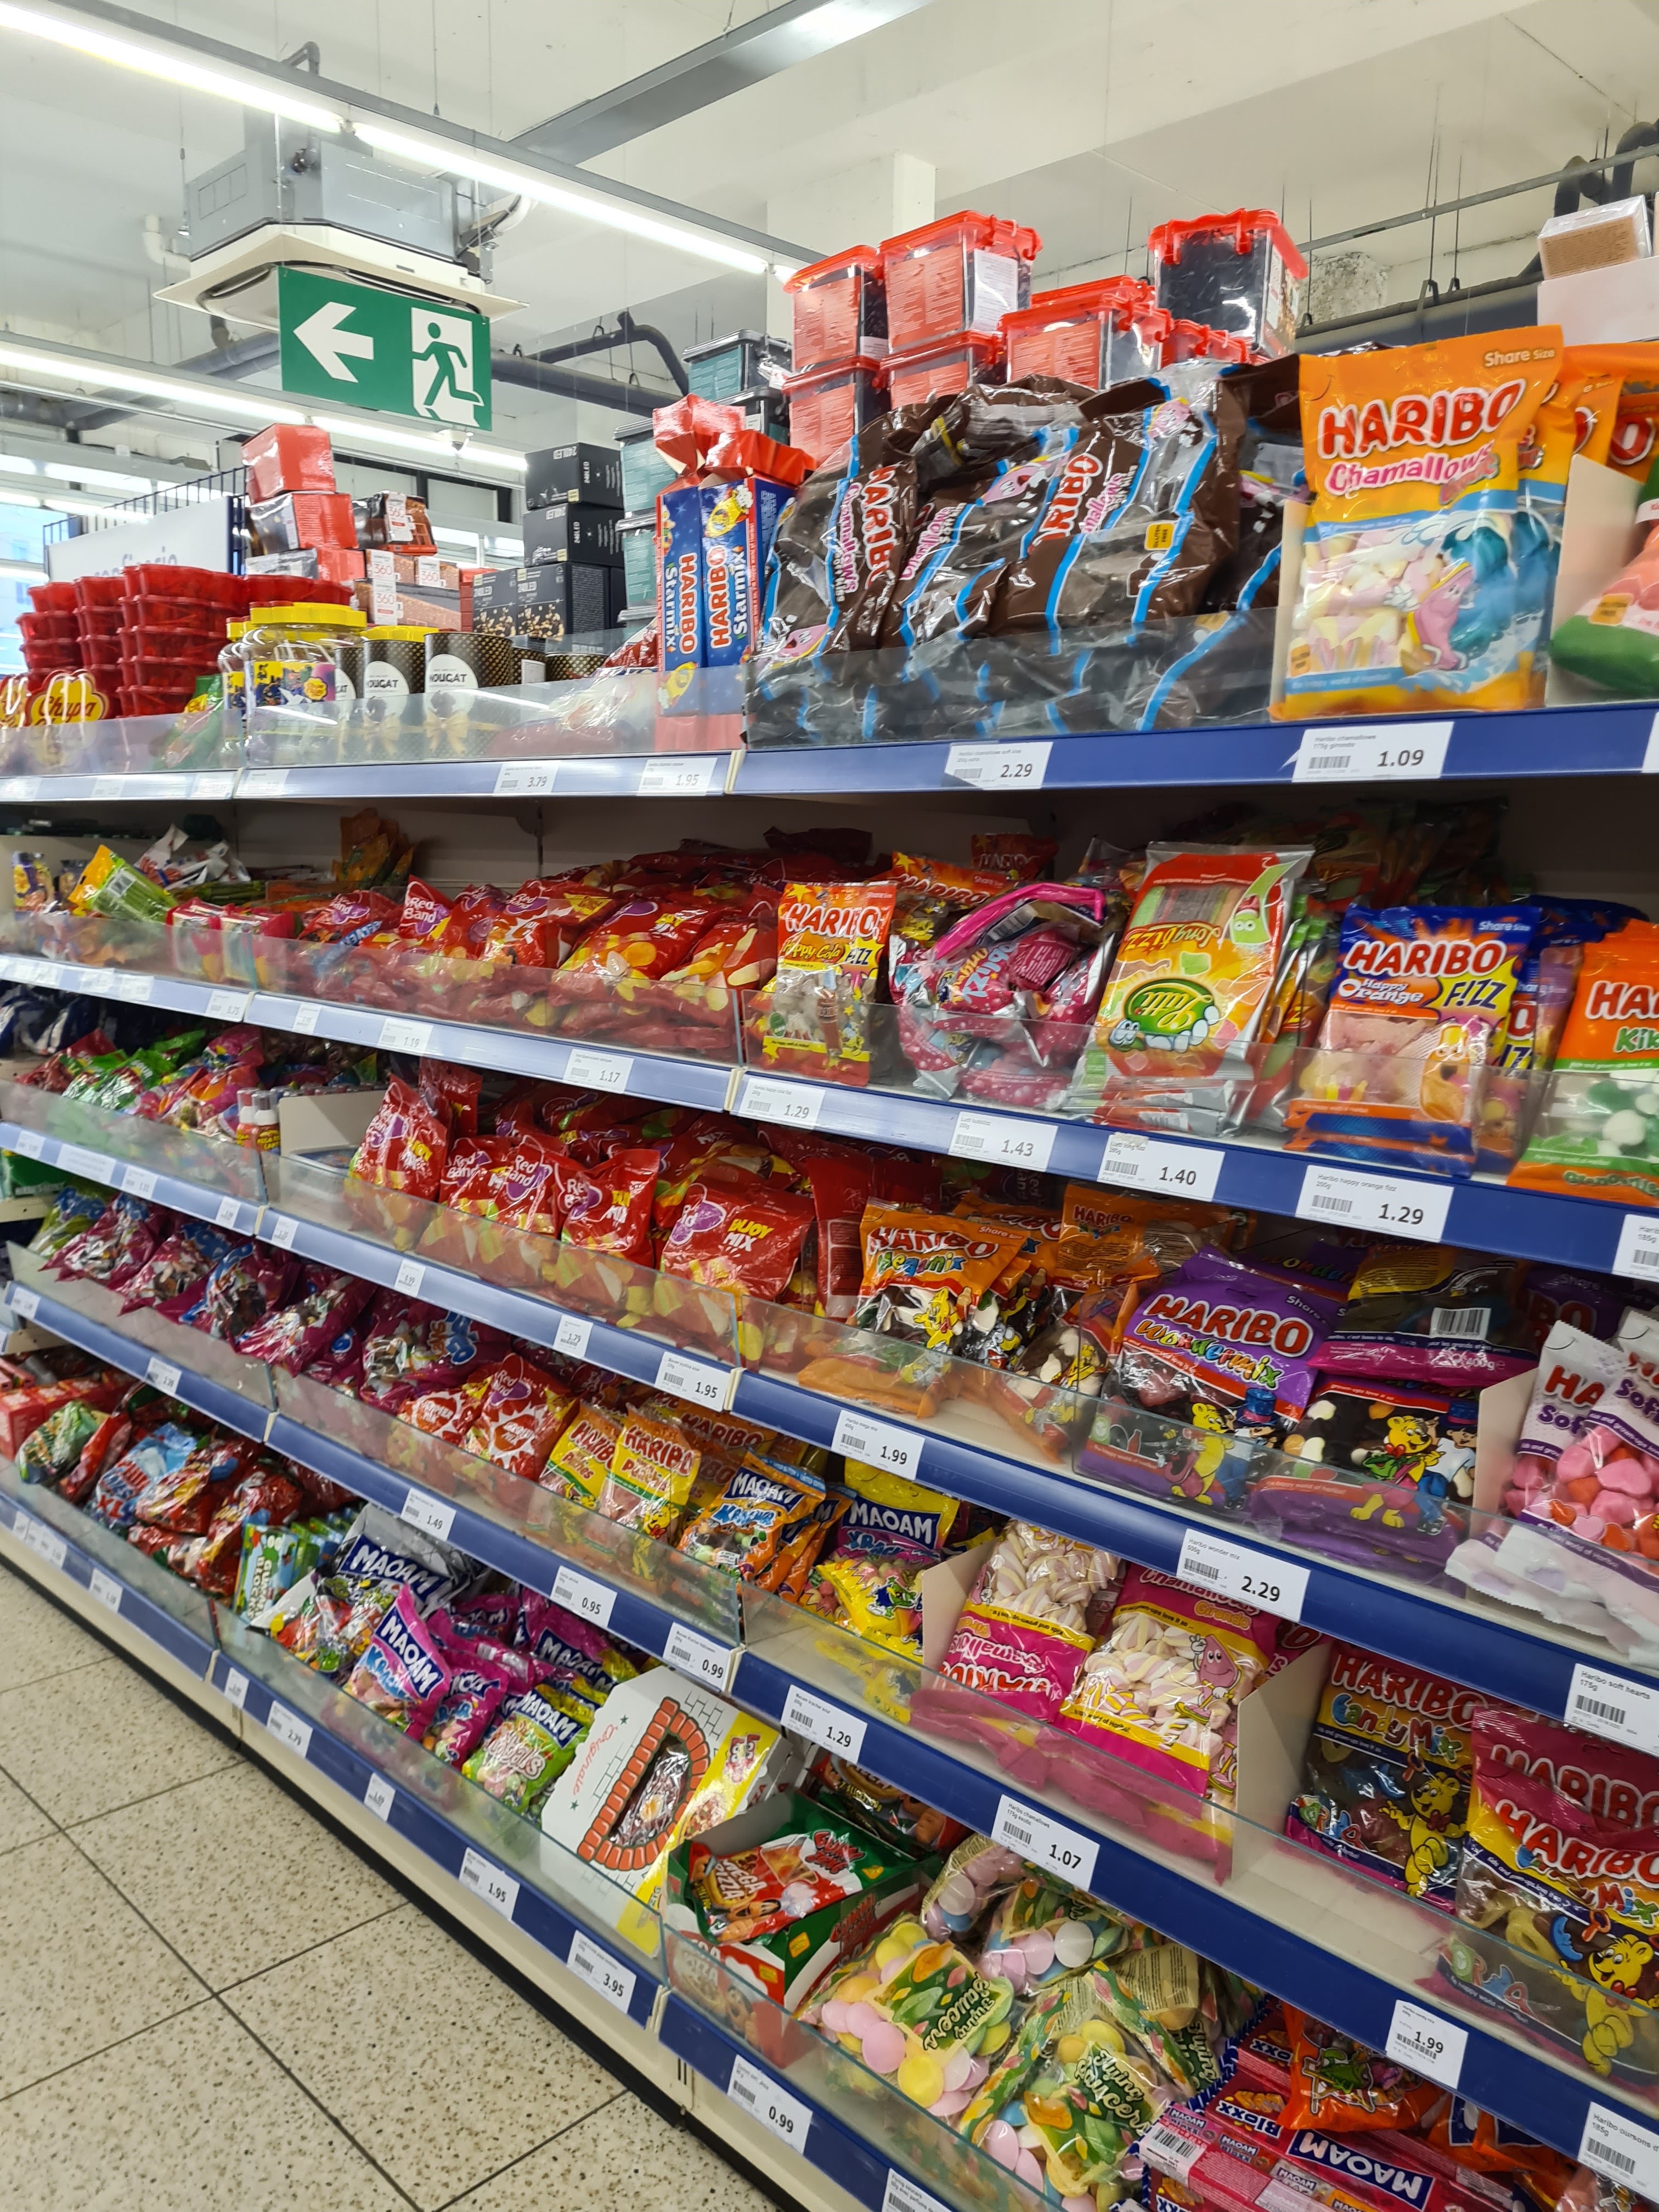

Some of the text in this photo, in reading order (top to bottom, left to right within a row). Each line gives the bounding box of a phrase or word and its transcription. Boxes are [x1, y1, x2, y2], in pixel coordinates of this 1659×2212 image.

[1484, 348, 1556, 367] Share Size
[1319, 380, 1525, 459] HARIBO
[1328, 442, 1494, 495] Chamallows
[375, 563, 392, 575] 360
[421, 571, 439, 582] 360
[376, 592, 395, 605] 360
[679, 552, 697, 654] HARIBO
[707, 546, 732, 648] HARIBO
[733, 551, 748, 635] Starmix
[665, 566, 678, 647] Starmix
[428, 673, 467, 683] NOUGAT
[40, 695, 98, 722] Chupa
[1376, 748, 1425, 768] 1.09
[527, 776, 548, 788] 3.79
[675, 773, 700, 786] 1.95
[1000, 763, 1033, 778] 2.29
[1479, 922, 1512, 932] Share
[816, 943, 842, 959] Cola
[1343, 940, 1507, 977] HARIBO
[1338, 982, 1425, 1005] Orange
[1138, 989, 1212, 1029] Lutti
[599, 1069, 622, 1084] 1.17
[783, 1104, 810, 1119] 1.29
[1001, 1139, 1035, 1157] 1.43
[514, 1154, 539, 1173] Red
[1158, 1166, 1197, 1186] 1.40
[1317, 1173, 1339, 1183] Haribo
[1339, 1176, 1361, 1188] happy
[1361, 1181, 1384, 1191] orange
[1073, 1204, 1134, 1227] HARIBO
[1378, 1203, 1425, 1226] 1.29
[723, 1232, 758, 1252] MIX
[978, 1225, 1006, 1238] Share
[1144, 1293, 1314, 1357] HARIBO
[693, 1381, 719, 1399] 1.95
[680, 1412, 765, 1449] HARIBO
[1537, 1404, 1587, 1436] Sof
[880, 1445, 909, 1465] 1.99
[427, 1515, 443, 1530] 1.49
[849, 1502, 933, 1545] MAOAM
[1188, 1538, 1207, 1549] Haribo
[352, 1544, 438, 1593] MAOAM
[1240, 1575, 1281, 1603] 2.29
[581, 1596, 602, 1615] 0.95
[381, 1615, 442, 1695] MAOAM
[702, 1658, 724, 1679] 0.99
[1331, 1654, 1488, 1732] HARIBO
[1579, 1679, 1599, 1692] 175g
[1580, 1671, 1651, 1700] Haribo soft hearts
[520, 1690, 580, 1743] MAOAM
[1331, 1693, 1463, 1762] Candy Mix
[825, 1725, 851, 1748] 1.29
[1008, 1802, 1023, 1814] Haribo
[1048, 1844, 1082, 1870] 1.07
[715, 1860, 746, 1899] PIZZA
[723, 1858, 768, 1894] MEGA
[488, 1881, 507, 1903] 1.95
[1596, 1883, 1658, 1928] Mix
[602, 1973, 624, 1997] 3.95
[1414, 2030, 1445, 2055] 1.99
[1096, 2050, 1146, 2102] Flying
[1074, 2056, 1154, 2136] Saucers
[768, 2106, 794, 2134] 0.99
[1170, 2108, 1206, 2128] MAOAM
[1593, 2114, 1654, 2151] Haribo oursons
[1220, 2134, 1259, 2155] MAOAM
[1301, 2131, 1424, 2200] MAOAM
[1278, 2167, 1317, 2189] MAOAM
